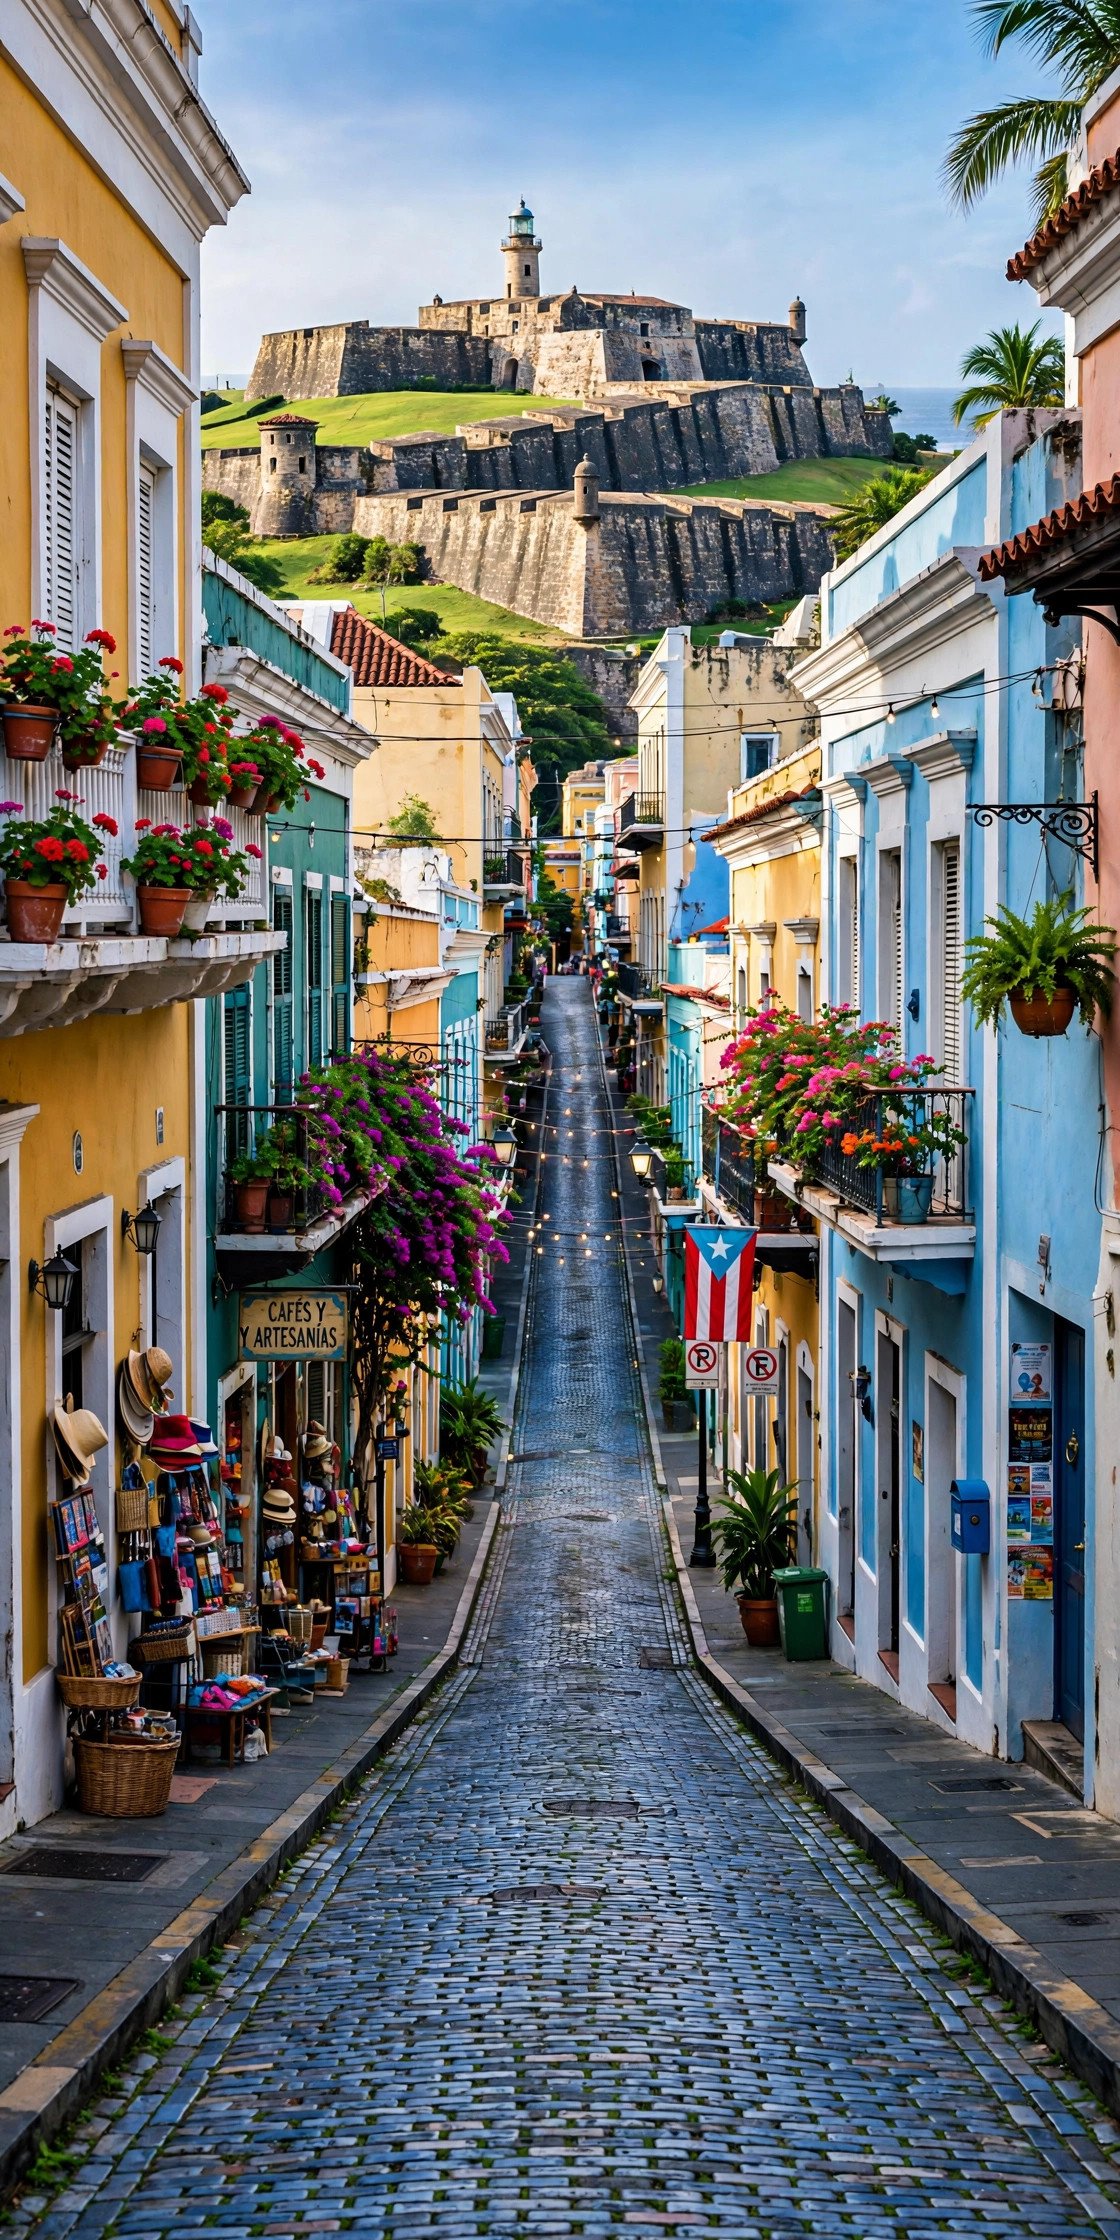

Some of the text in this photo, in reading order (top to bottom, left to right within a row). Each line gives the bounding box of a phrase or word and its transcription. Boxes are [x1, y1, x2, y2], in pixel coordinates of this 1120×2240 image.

[268, 1298, 326, 1322] CAFÉS Y
[240, 1323, 337, 1348] Y ARTESANÍAS
